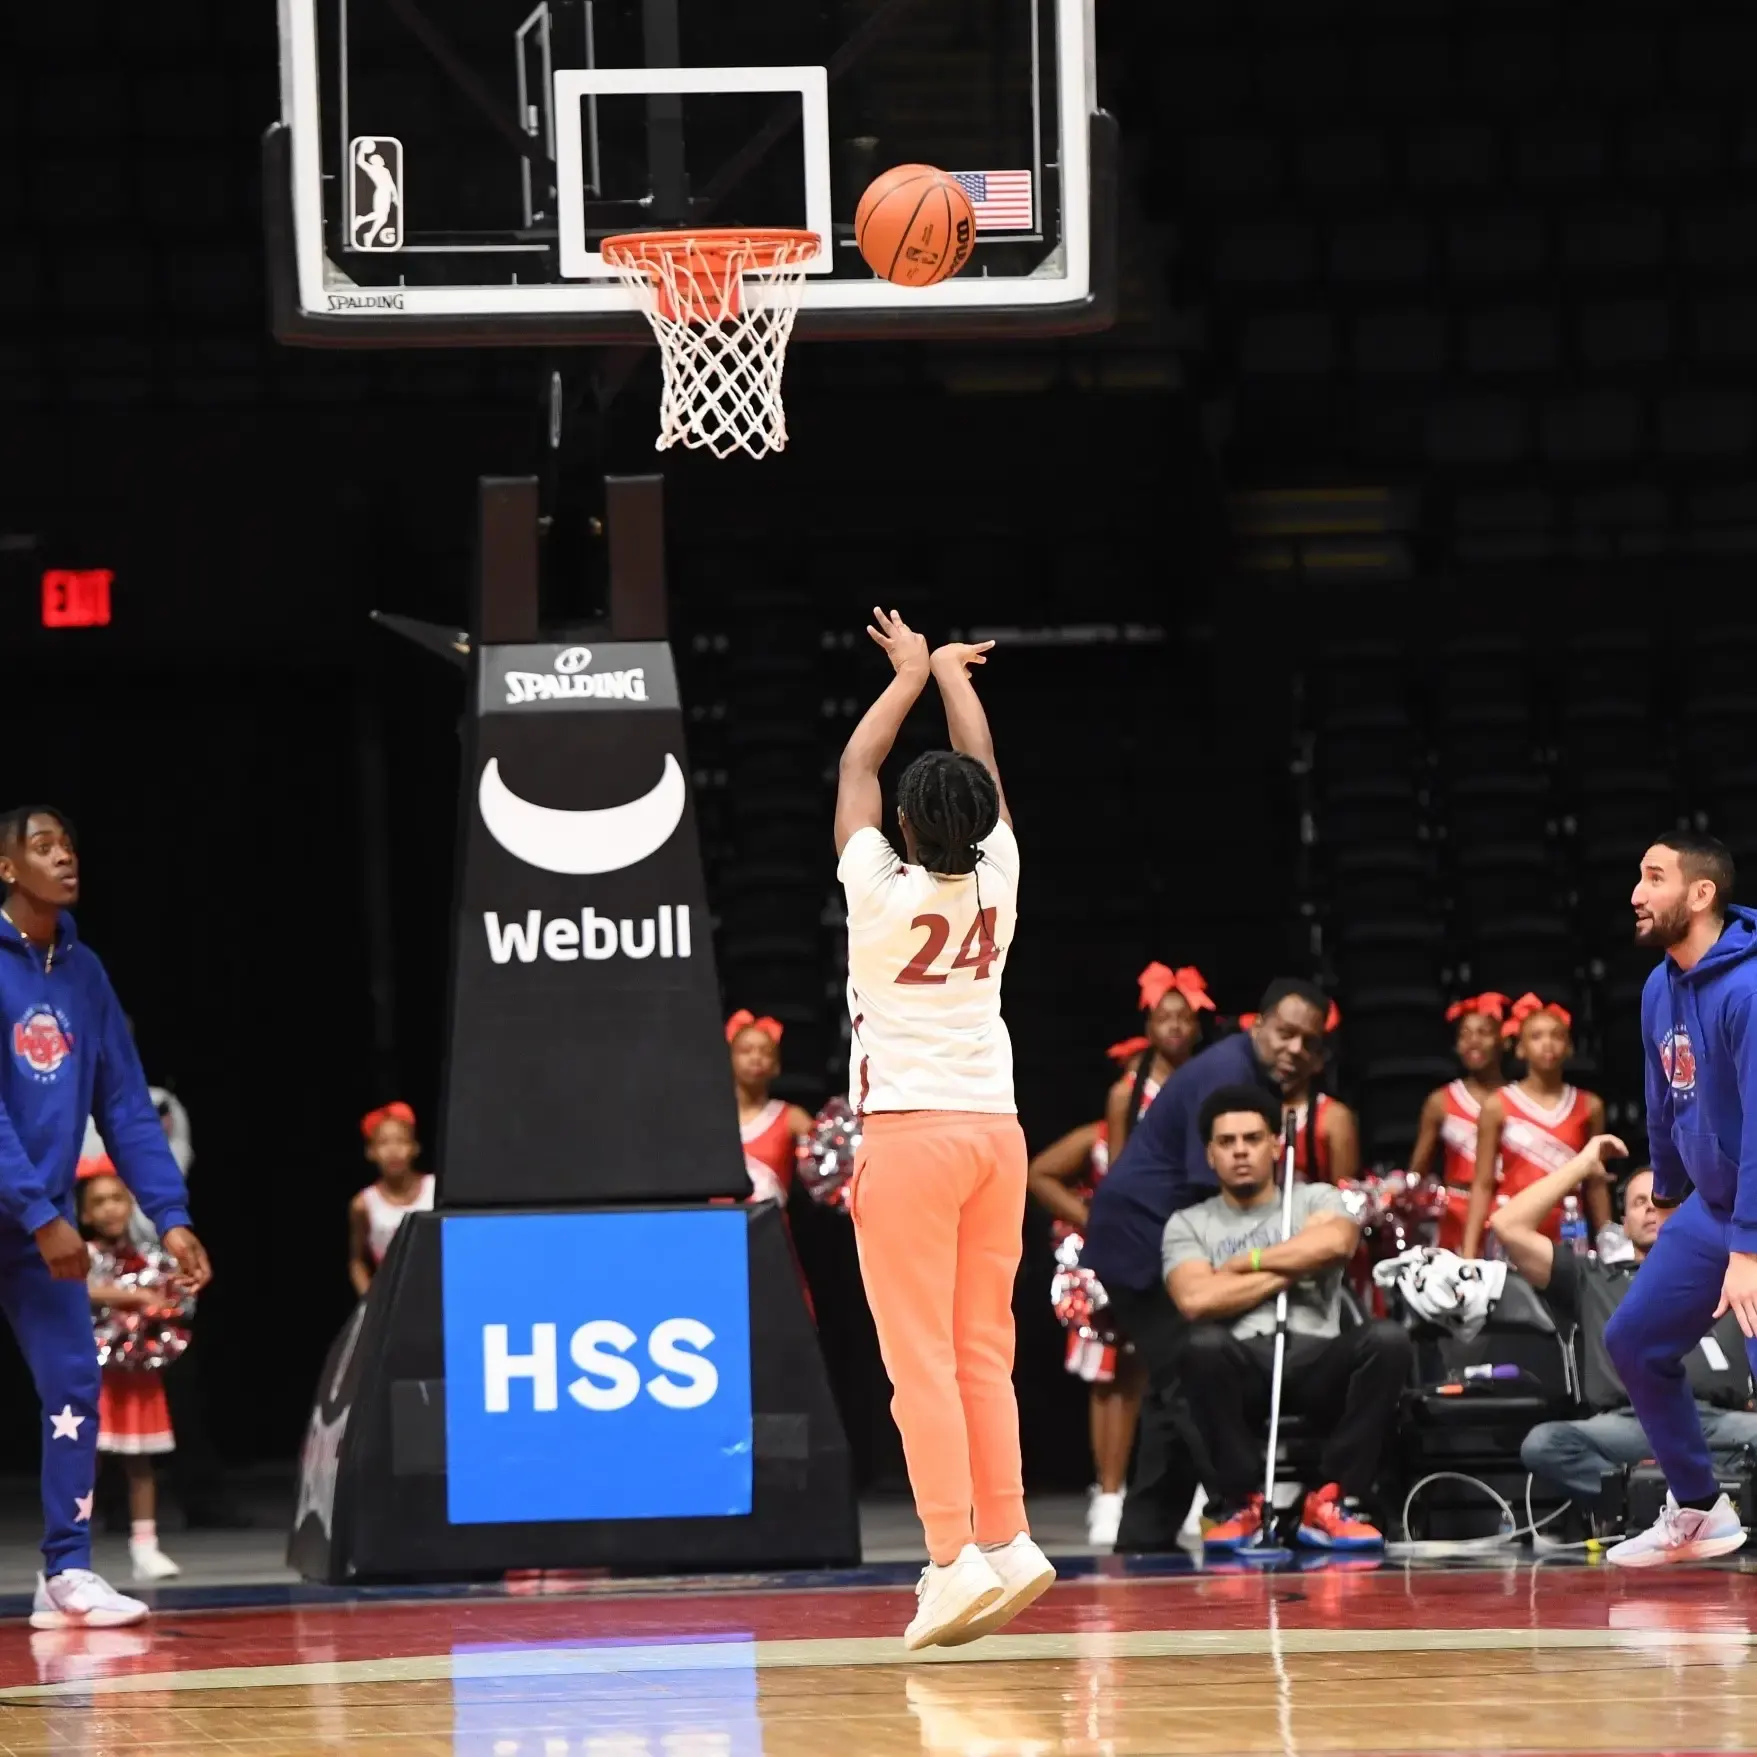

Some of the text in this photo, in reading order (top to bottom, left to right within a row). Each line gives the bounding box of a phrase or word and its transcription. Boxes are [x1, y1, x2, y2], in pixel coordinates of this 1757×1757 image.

[327, 294, 405, 311] SPALDING
[504, 667, 649, 704] SPALDING
[483, 904, 692, 965] Webull
[893, 906, 1000, 985] 24
[482, 1317, 719, 1413] HSS
